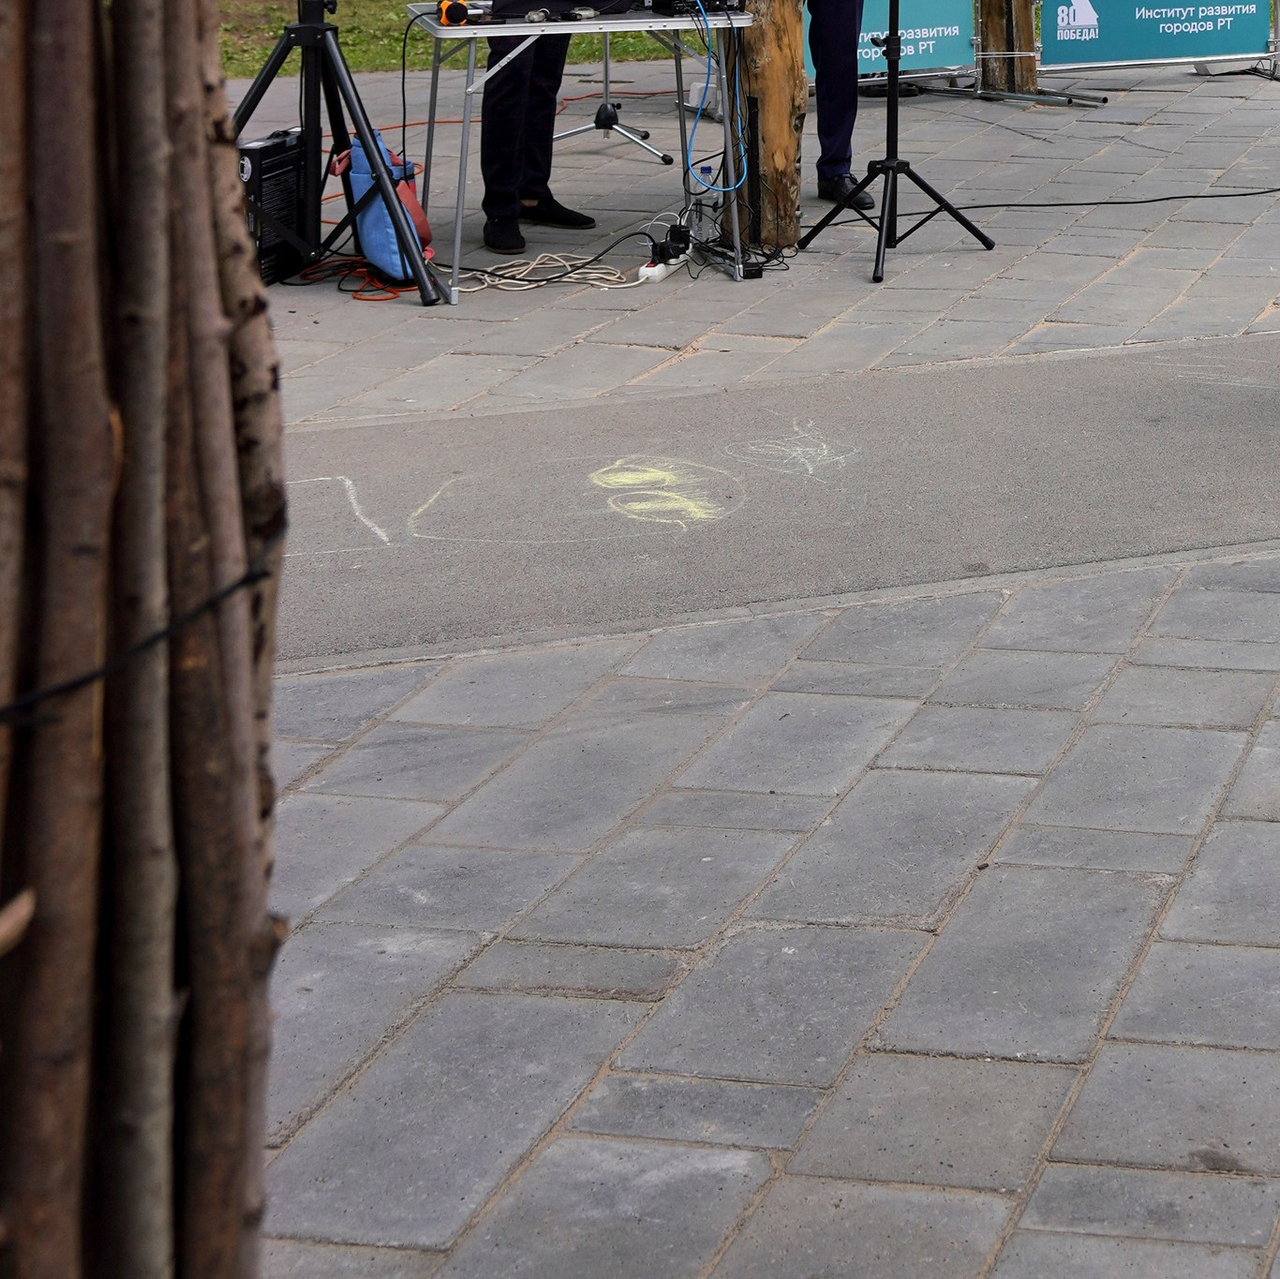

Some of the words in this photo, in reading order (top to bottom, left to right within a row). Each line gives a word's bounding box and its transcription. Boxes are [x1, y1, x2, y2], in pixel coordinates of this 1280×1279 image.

[1135, 7, 1195, 20] Институт
[1199, 4, 1256, 18] развития
[898, 26, 959, 41] развития
[1057, 27, 1099, 41] ПОБЕДА!
[1159, 21, 1213, 35] городов
[1217, 18, 1233, 30] РТ
[918, 41, 936, 54] РТ
